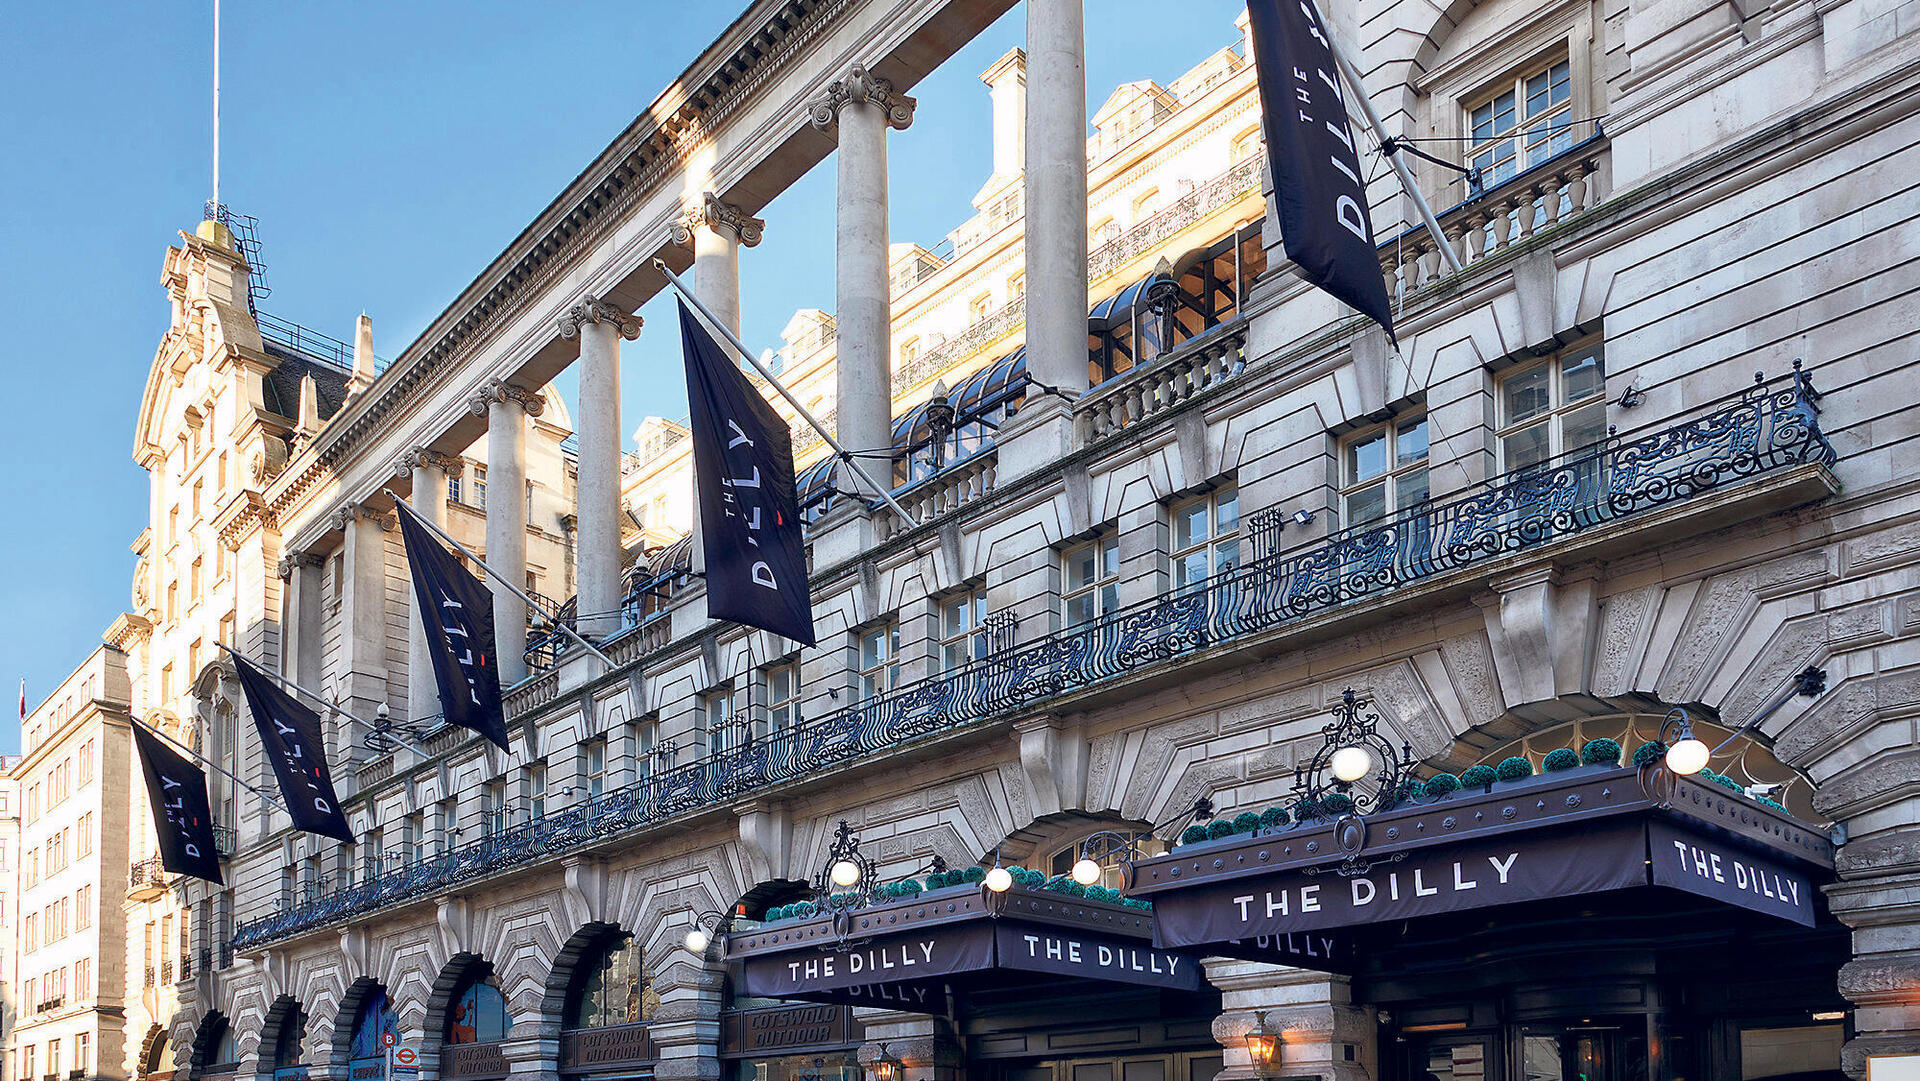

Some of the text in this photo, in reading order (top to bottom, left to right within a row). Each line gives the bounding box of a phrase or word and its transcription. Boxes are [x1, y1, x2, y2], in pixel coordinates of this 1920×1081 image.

[1293, 66, 1314, 123] THE
[722, 477, 736, 517] THE
[273, 718, 332, 815] DILY
[1233, 852, 1519, 922] THE DILLY
[1673, 840, 1799, 906] THE DILLY
[788, 940, 935, 982] THE DILLY
[1023, 934, 1179, 976] THE DILLY
[583, 1029, 645, 1047] COTSWOLD
[752, 1006, 838, 1029] COTSWOLD
[755, 1026, 831, 1047] OUTDOOR
[586, 1045, 641, 1062] OUTDOOR
